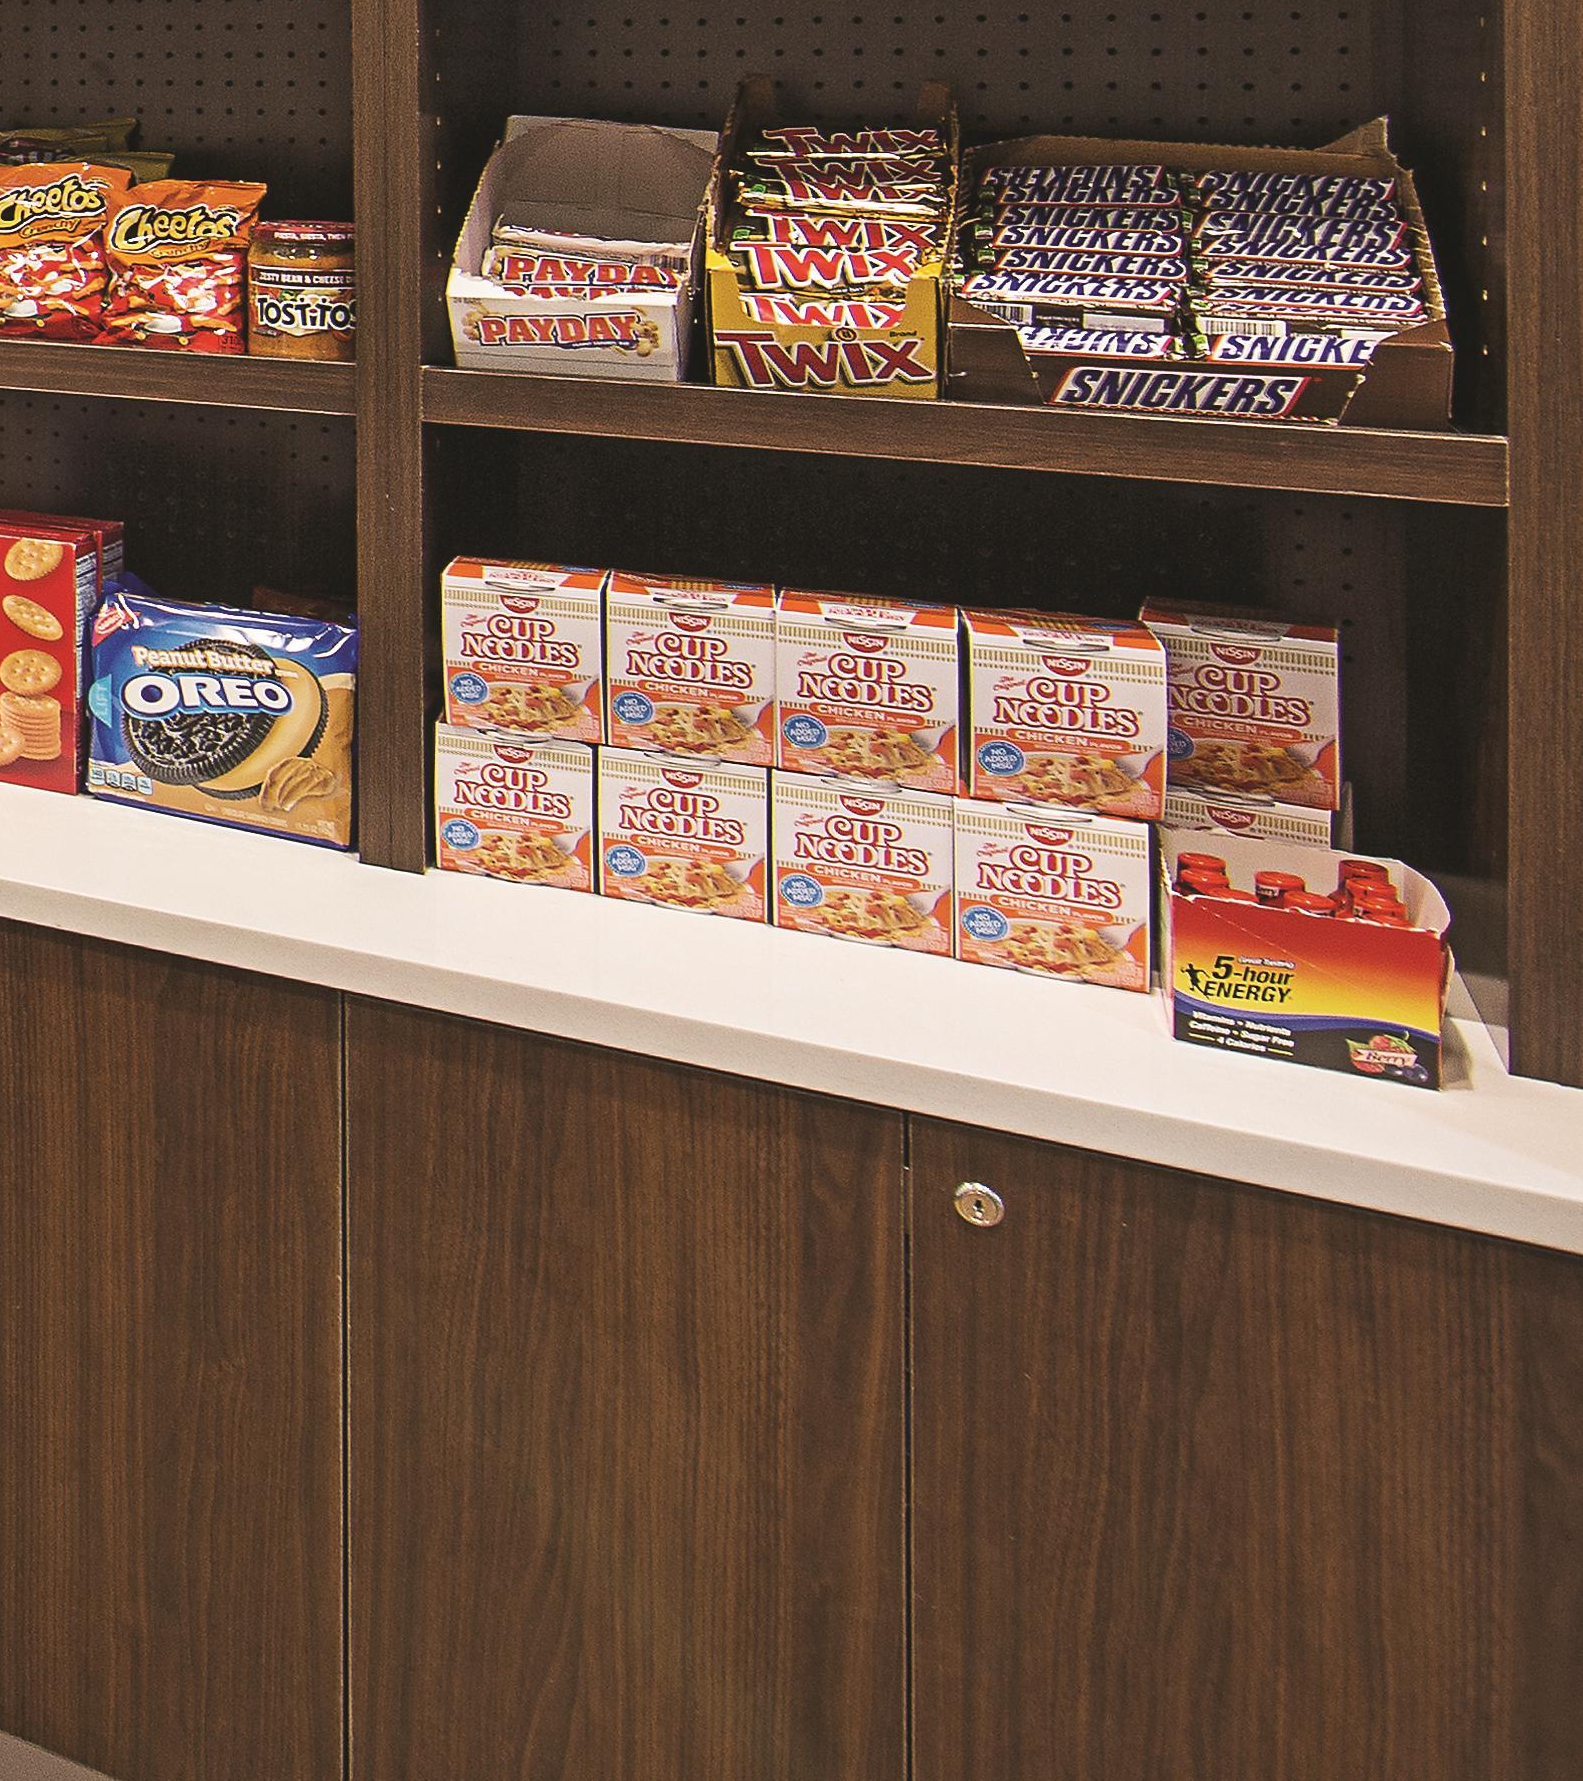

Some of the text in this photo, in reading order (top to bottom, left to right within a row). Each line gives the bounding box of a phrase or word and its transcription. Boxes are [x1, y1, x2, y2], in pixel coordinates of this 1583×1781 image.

[112, 205, 238, 252] Cheetos
[997, 226, 1184, 257] SNICKERS
[478, 314, 639, 345] PAYDAY
[1055, 367, 1310, 418] SNICKERS
[487, 613, 552, 642] CUP
[134, 645, 274, 676] Peanut Butter
[460, 634, 579, 668] NOODLES
[479, 663, 539, 676] CHICKEN
[828, 653, 904, 686] CUP
[126, 676, 290, 714] OREO
[799, 673, 934, 712] NOODLES
[816, 705, 884, 721] CHICKEN
[1009, 845, 1093, 876] CUP
[978, 863, 1121, 908] NOODLES
[998, 896, 1067, 914] CHICKEN
[1212, 956, 1294, 985] 5-hour
[1206, 982, 1290, 1002] ENERGY
